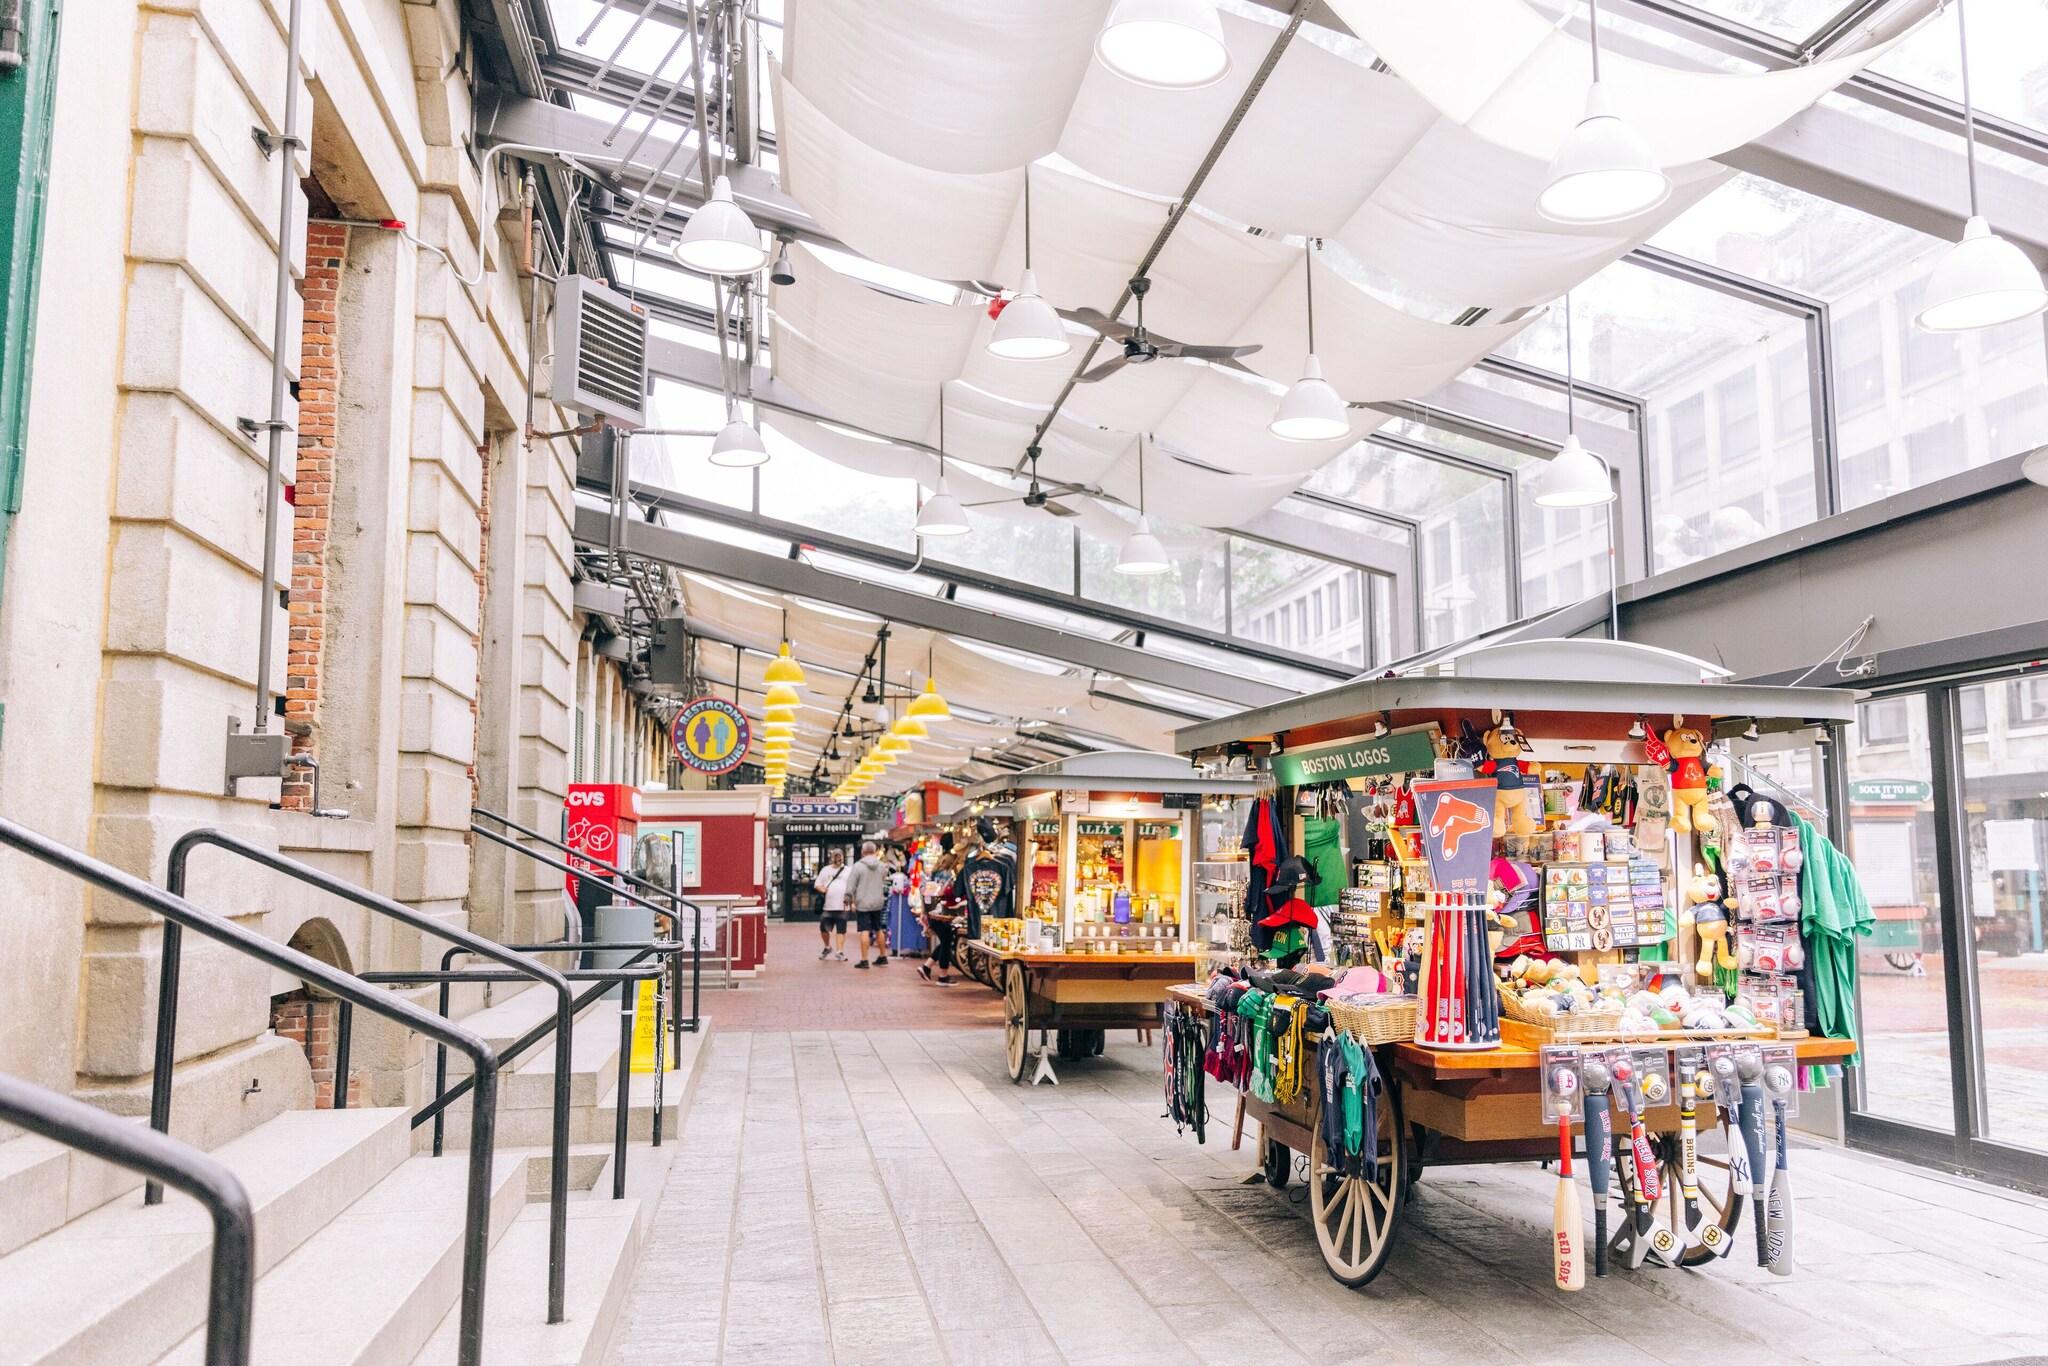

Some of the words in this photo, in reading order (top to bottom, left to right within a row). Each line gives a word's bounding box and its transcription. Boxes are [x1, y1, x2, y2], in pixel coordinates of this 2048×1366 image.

[679, 700, 746, 727] RESTROOMS
[677, 741, 746, 771] DOWNSTAIRS
[1301, 754, 1347, 776] BOSTON
[1347, 747, 1391, 768] LOGOS
[569, 791, 605, 807] CVS
[1859, 785, 1881, 794] SOCK
[1882, 785, 1892, 794] IT
[1893, 785, 1904, 794] TO
[775, 803, 853, 814] BOSTON
[785, 824, 813, 832] Cantina
[823, 824, 849, 832] Tequila
[850, 824, 864, 832] Bar
[1633, 1135, 1656, 1164] RED
[1686, 1138, 1696, 1175] BRUINS
[1644, 1168, 1658, 1198] SOX
[1557, 1231, 1571, 1255] RED
[1767, 1229, 1785, 1271] YORK
[1558, 1260, 1572, 1284] SOX
